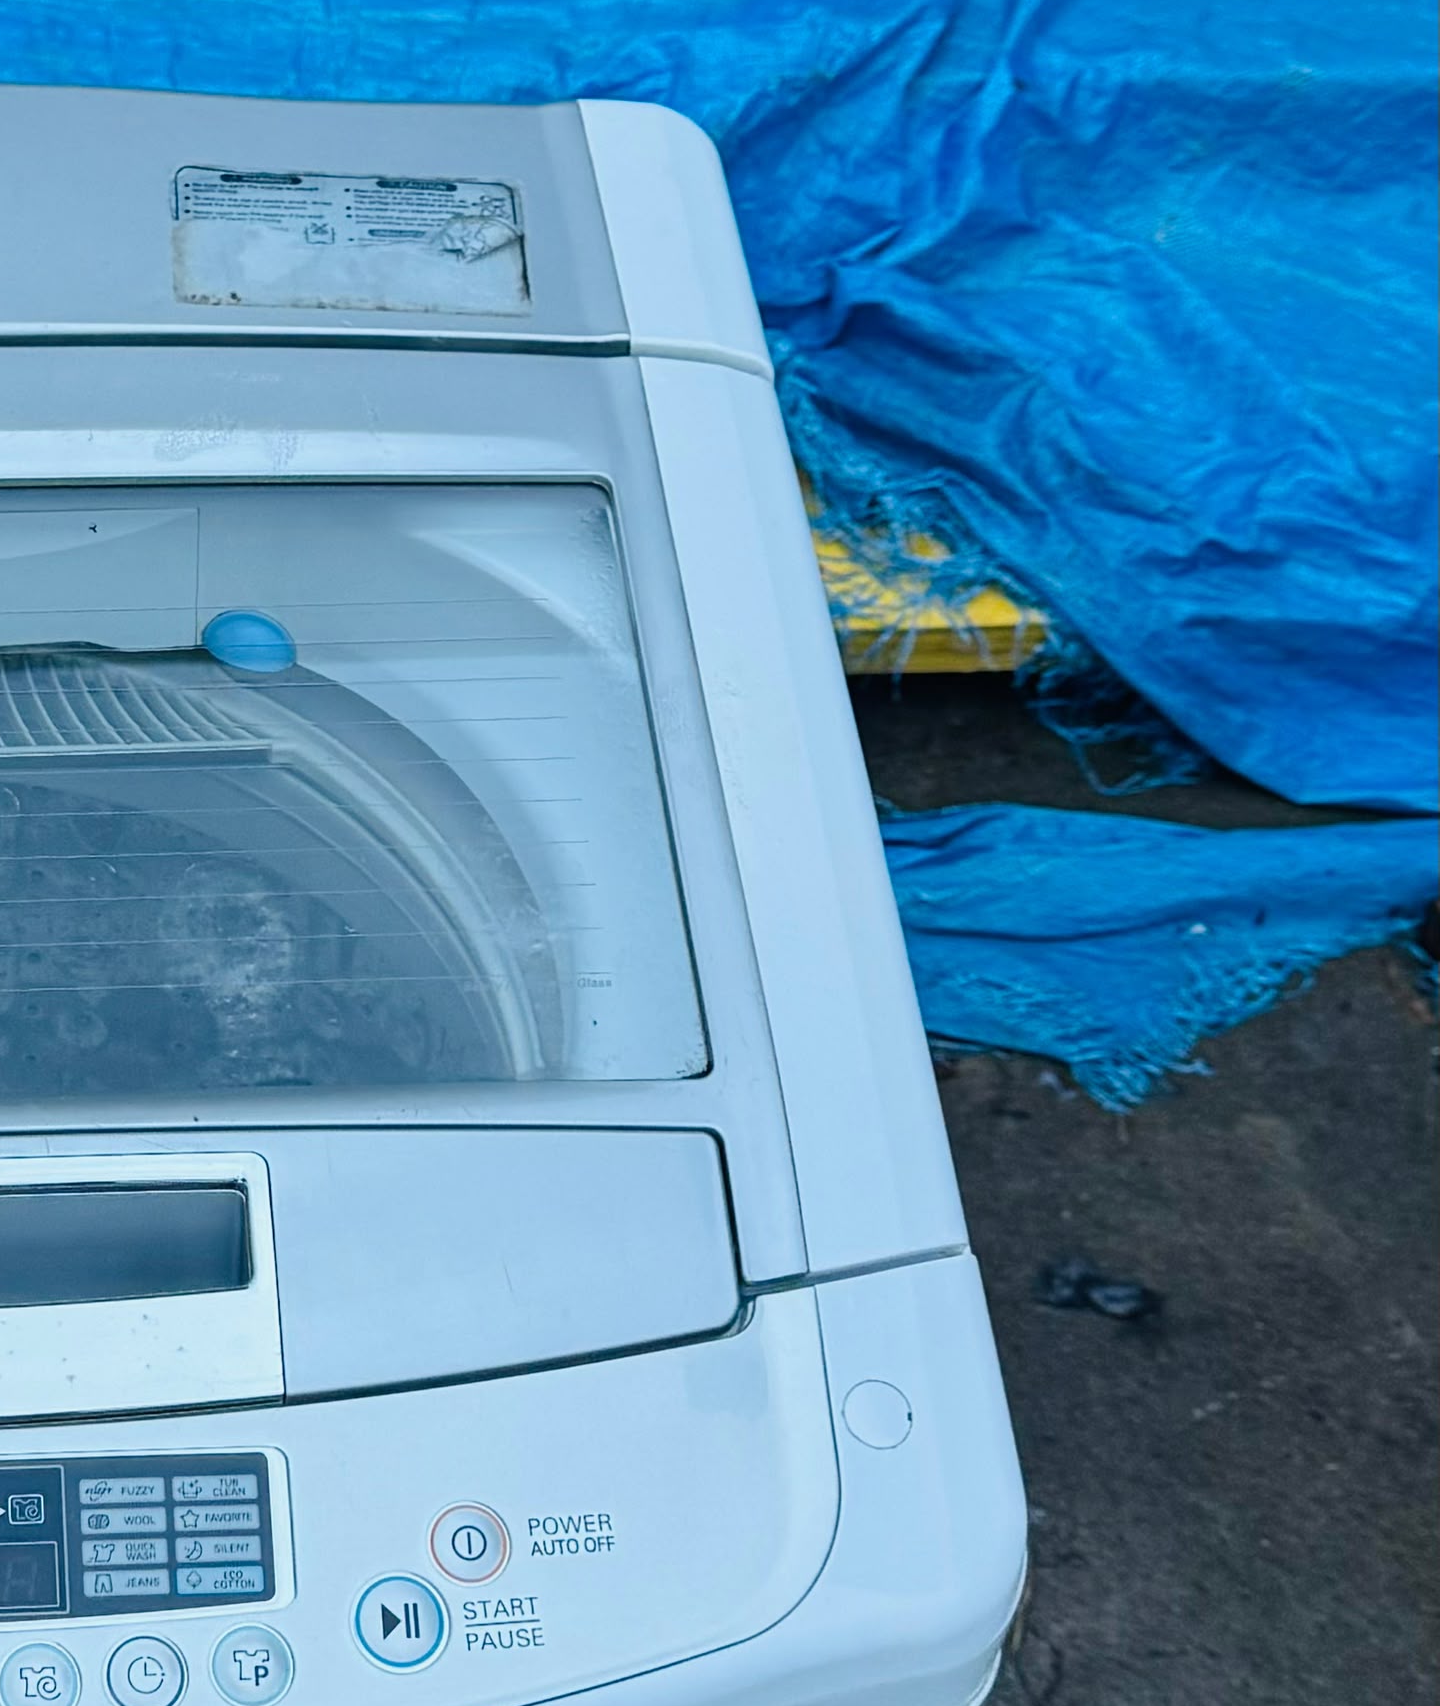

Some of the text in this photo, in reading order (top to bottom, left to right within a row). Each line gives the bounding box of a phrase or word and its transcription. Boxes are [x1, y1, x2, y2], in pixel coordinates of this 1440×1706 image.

[121, 1486, 155, 1495] FUZZY
[213, 1487, 246, 1497] CLEAN
[124, 1515, 156, 1526] WOOL
[527, 1513, 613, 1536] POWER
[125, 1542, 156, 1552] QUICK
[213, 1543, 250, 1554] SILENT
[531, 1535, 616, 1556] AUTO OFF
[125, 1551, 157, 1561] WASH
[125, 1577, 160, 1587] JEANS
[213, 1579, 255, 1590] COTTON
[462, 1596, 539, 1620] START
[465, 1627, 545, 1651] PAUSE
